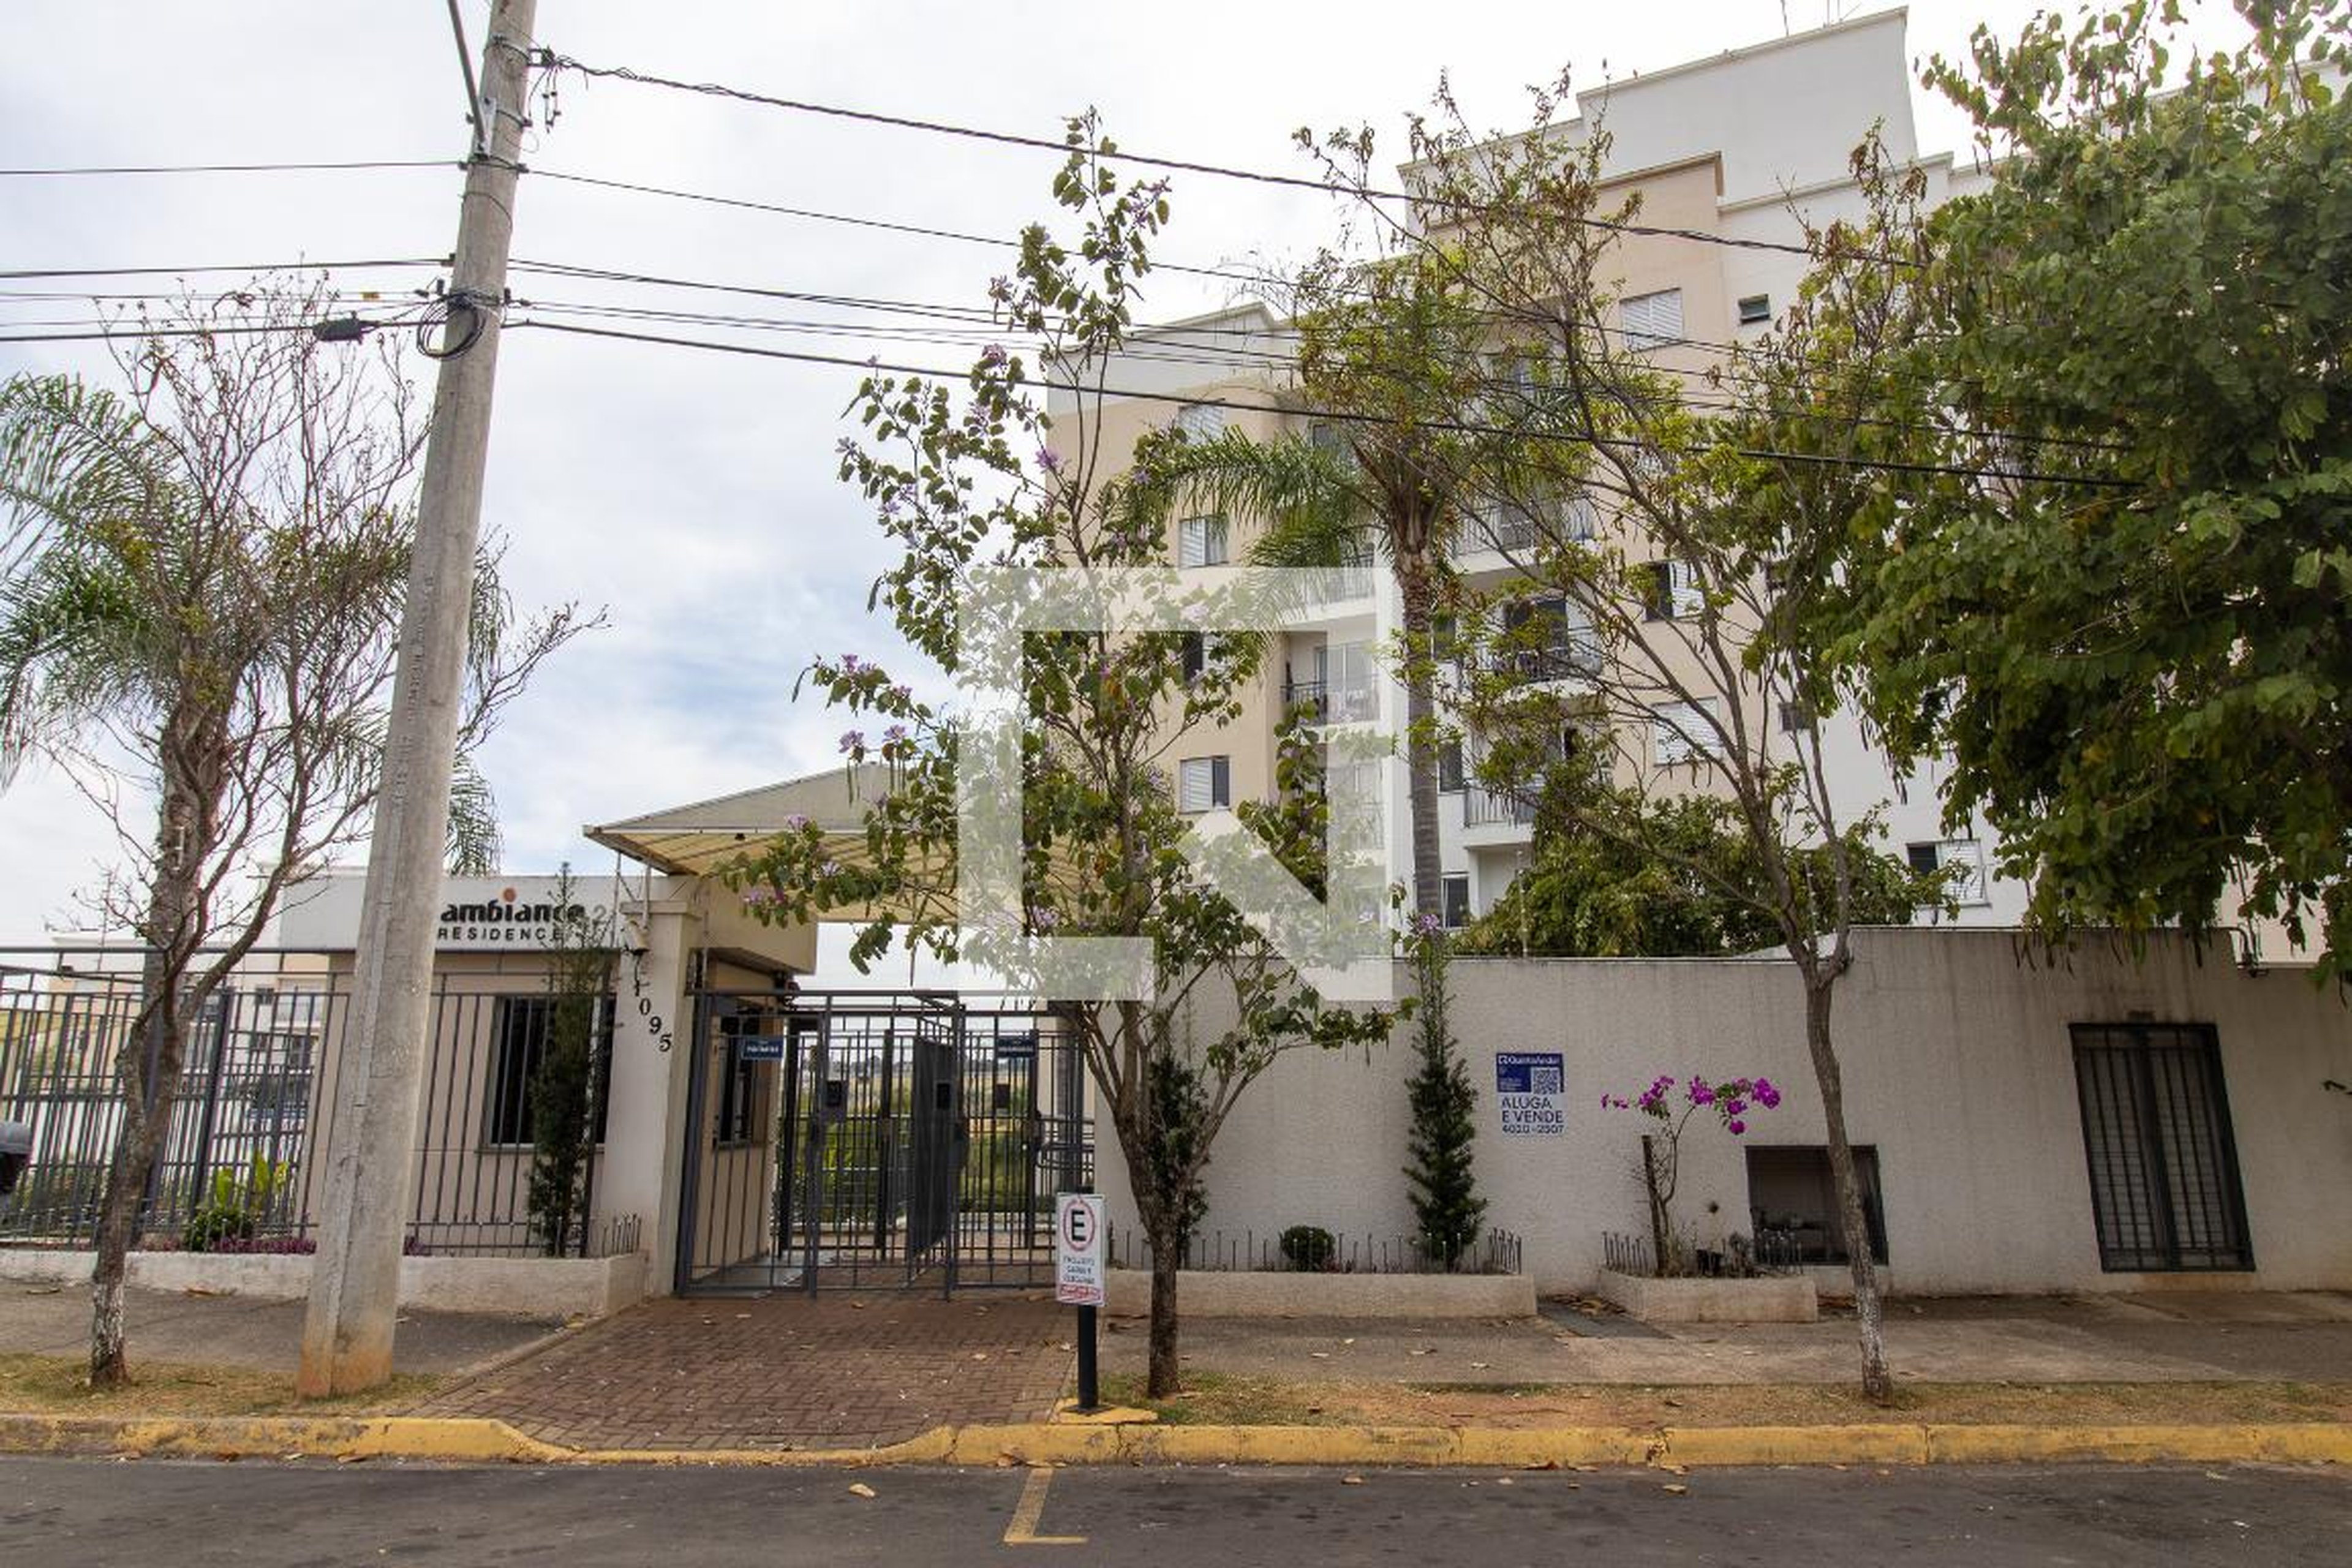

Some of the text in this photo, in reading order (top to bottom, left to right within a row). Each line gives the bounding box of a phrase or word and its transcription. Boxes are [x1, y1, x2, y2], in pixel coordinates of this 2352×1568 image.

[437, 927, 565, 941] RESIDENCE
[1502, 1097, 1552, 1109] ALUGA
[1502, 1110, 1564, 1123] E VENDE
[1071, 1209, 1087, 1242] E
